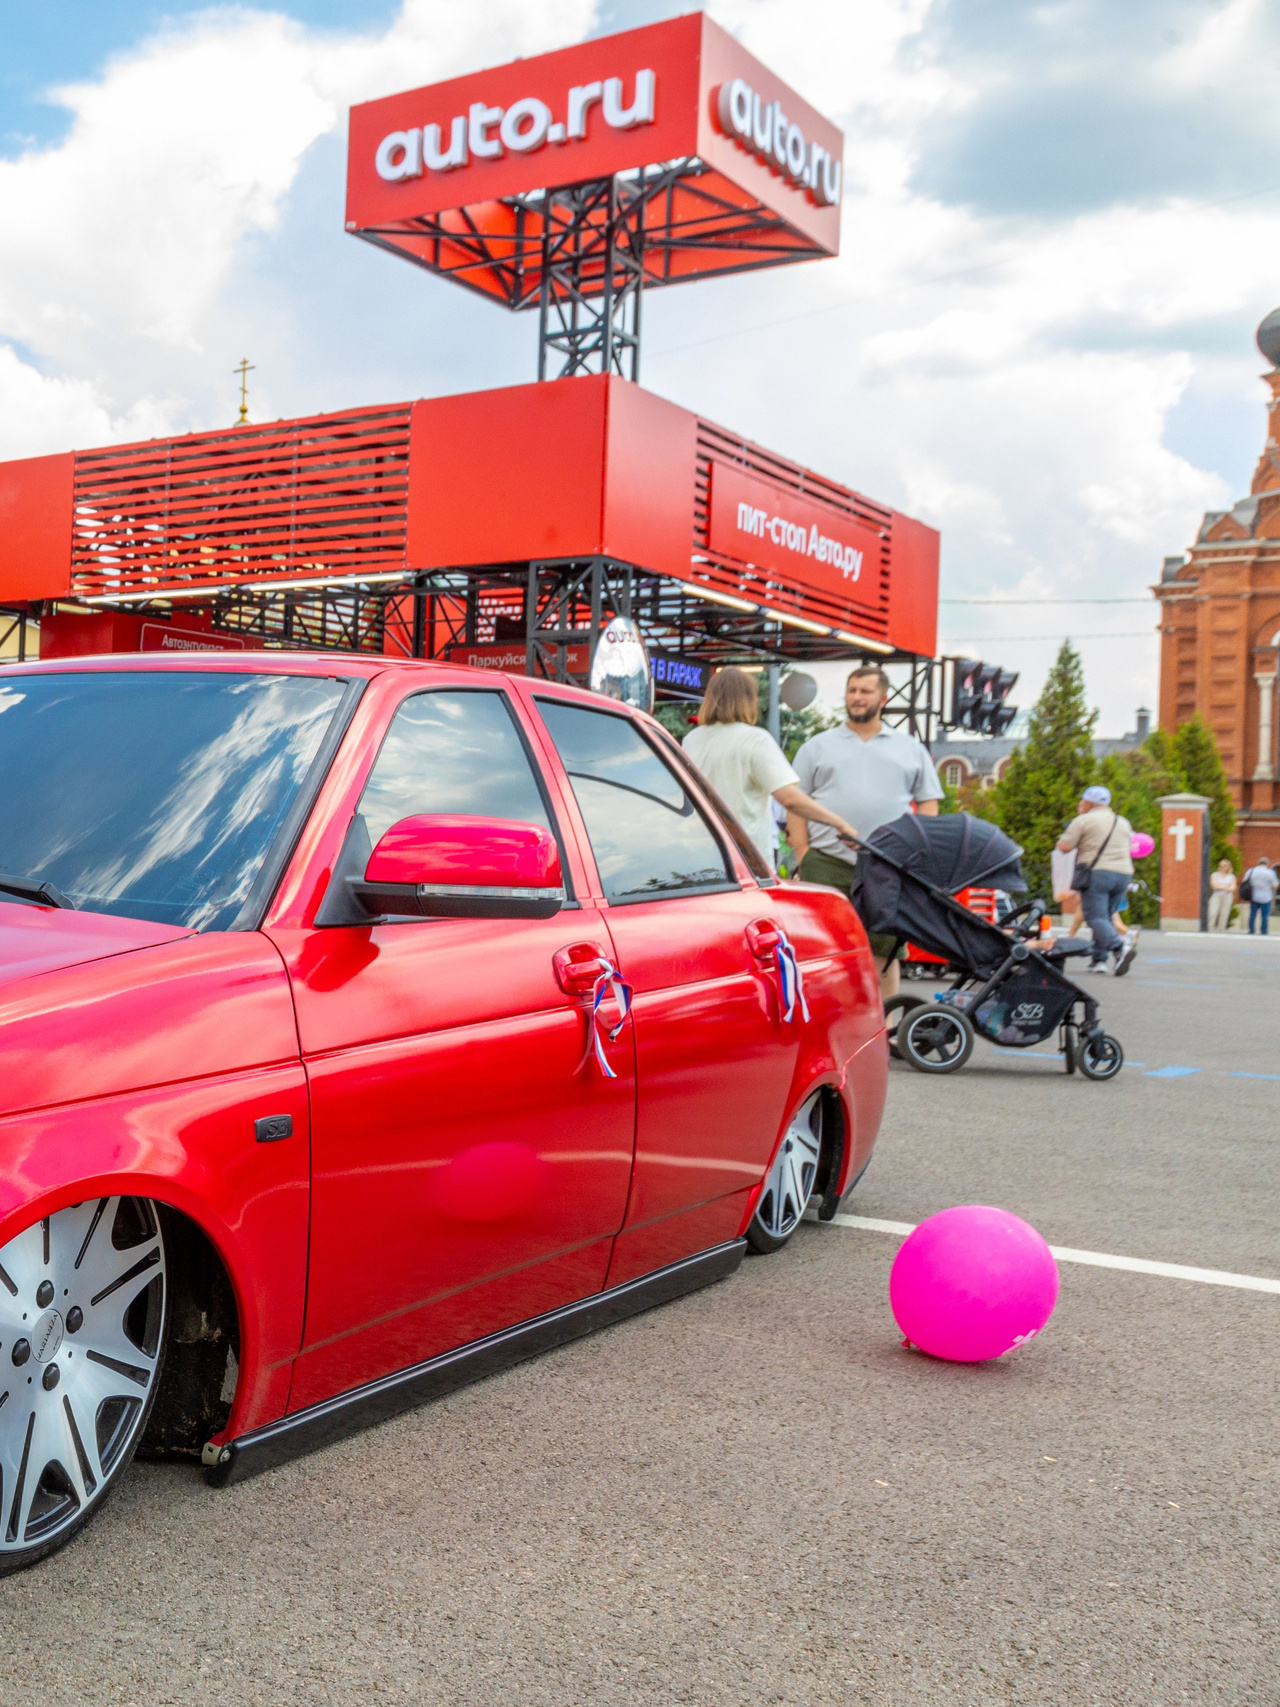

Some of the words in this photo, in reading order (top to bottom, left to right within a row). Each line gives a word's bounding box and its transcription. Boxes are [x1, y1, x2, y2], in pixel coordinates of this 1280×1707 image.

[375, 69, 656, 182] auto.ru
[720, 78, 841, 206] auto.ru
[737, 502, 806, 555] пит-стоп
[807, 524, 863, 582] Авто.ру
[657, 658, 666, 680] В
[667, 661, 702, 688] ГАРАЖ
